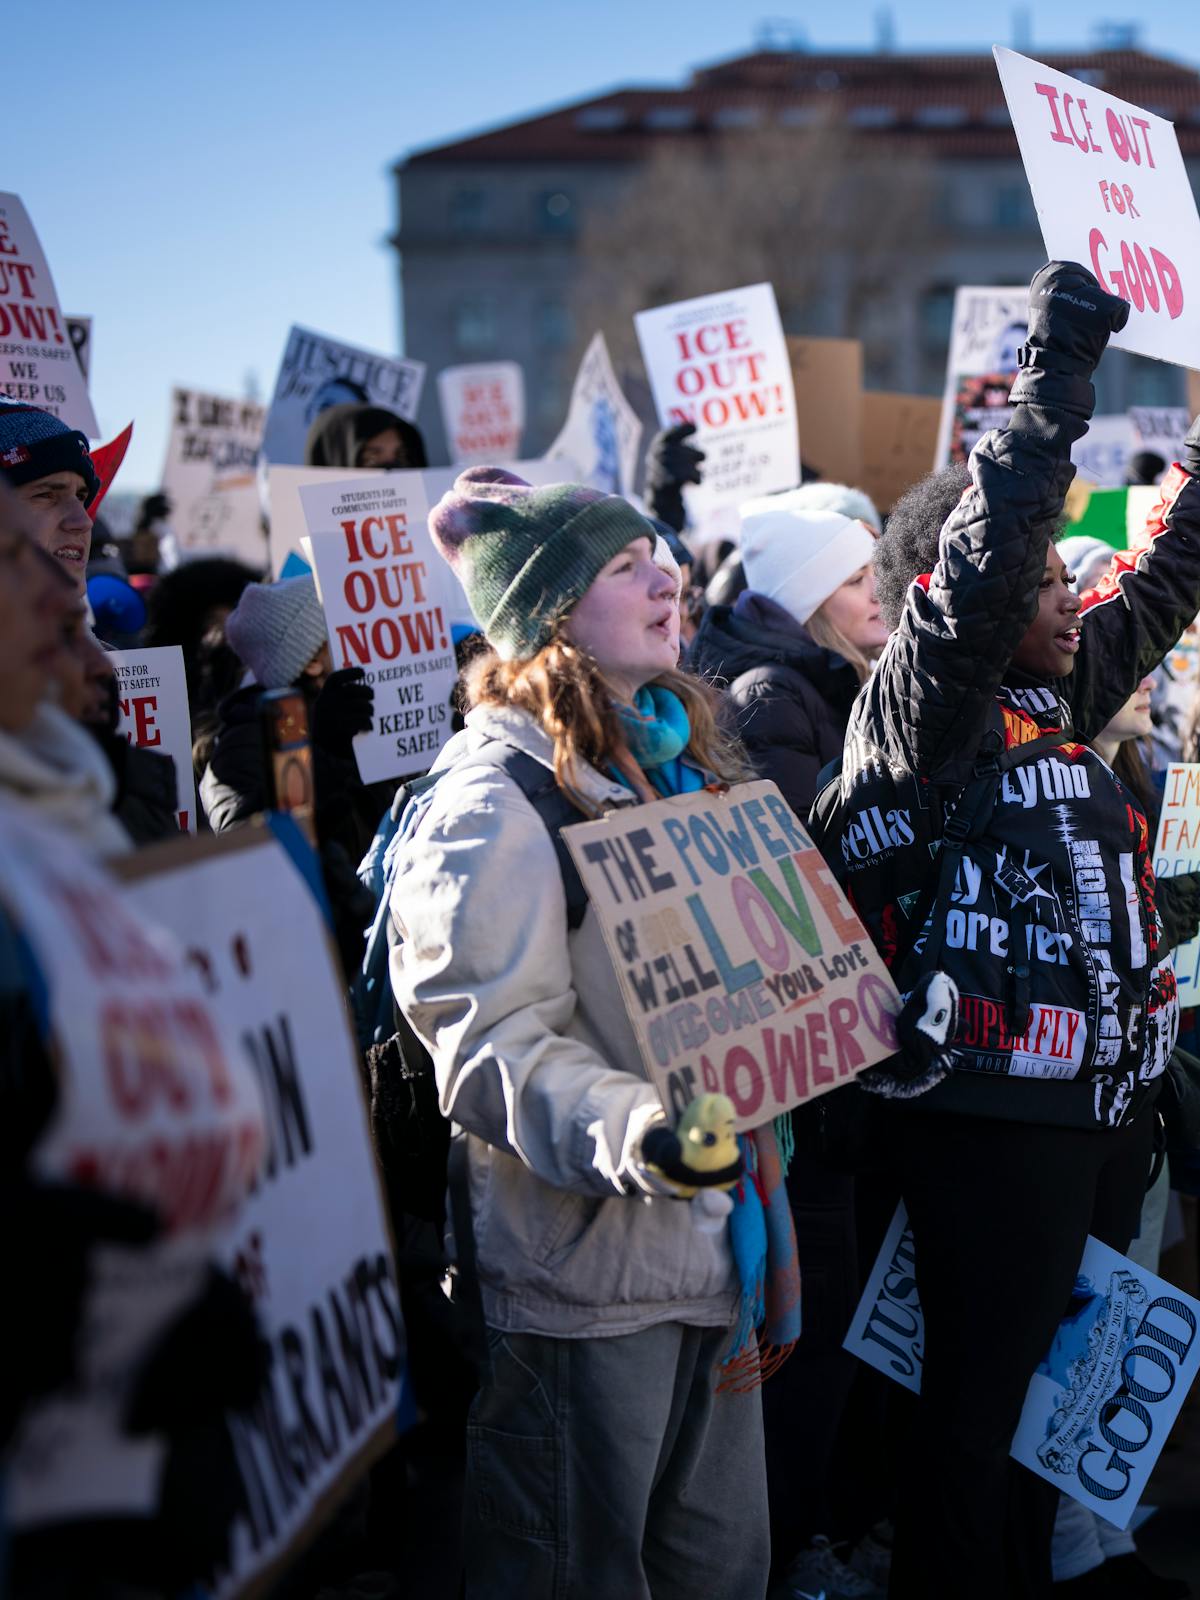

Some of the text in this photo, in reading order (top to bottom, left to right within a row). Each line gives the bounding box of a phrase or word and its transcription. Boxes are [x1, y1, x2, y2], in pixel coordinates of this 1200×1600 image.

[1034, 82, 1156, 169] ICE OUT
[1099, 180, 1141, 219] FOR
[1089, 228, 1185, 320] GOOD
[676, 319, 752, 362] ICE
[9, 362, 38, 379] WE
[676, 351, 766, 397] OUT
[44, 385, 66, 403] US
[669, 384, 784, 427] NOW!
[340, 513, 414, 564] ICE
[344, 561, 427, 614] OUT
[336, 607, 449, 669] NOW!
[130, 676, 161, 691] SAFETY
[132, 664, 149, 676] FOR
[378, 664, 412, 683] KEEPS
[414, 661, 428, 674] US
[397, 682, 424, 705] WE
[380, 703, 446, 736] KEEP US
[396, 728, 440, 757] SAFE!
[582, 794, 817, 903] THE POWER
[685, 849, 869, 995] LOVE
[1064, 885, 1080, 934] LISTEN
[614, 919, 639, 964] OF
[627, 944, 721, 1014] WILL
[764, 965, 825, 1007] YOUR
[820, 944, 870, 981] LOVE
[955, 996, 1079, 1059] UPERFLY
[667, 996, 867, 1118] OF POWER
[975, 1055, 1018, 1074] WORLD
[1024, 1061, 1036, 1075] IS
[1041, 1064, 1074, 1081] MINE
[1076, 1389, 1097, 1417] Nicole
[1077, 1296, 1197, 1500] GOOD
